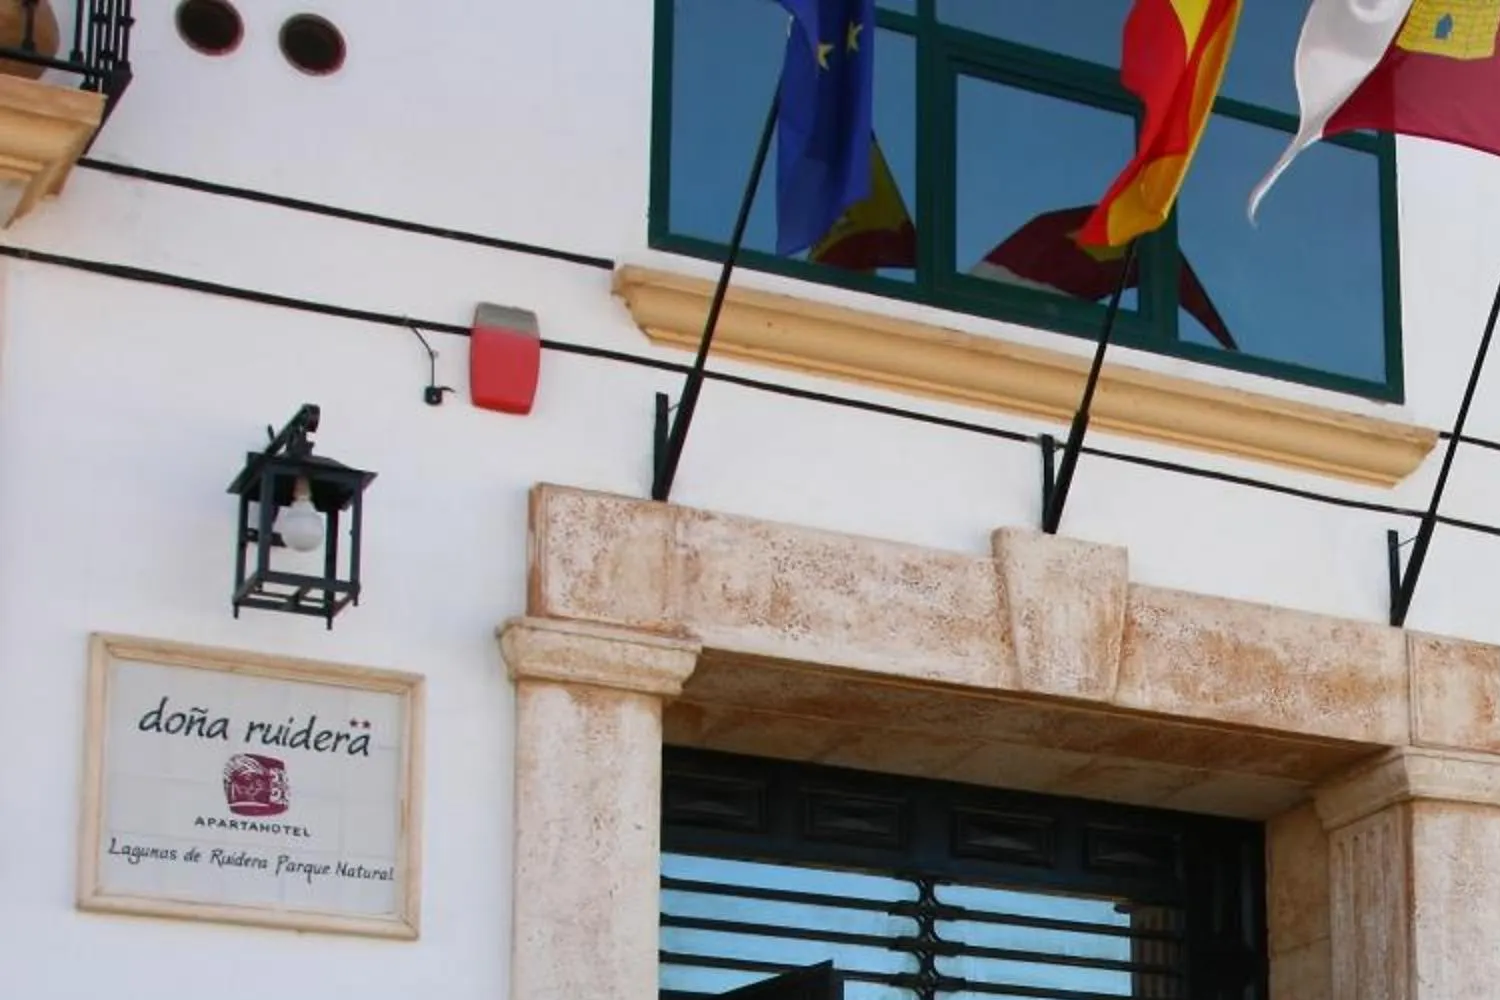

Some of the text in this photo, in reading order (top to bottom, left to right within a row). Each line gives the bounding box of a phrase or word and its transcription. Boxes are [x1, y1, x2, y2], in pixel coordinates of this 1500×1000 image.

[138, 696, 371, 757] doña ruidera
[195, 816, 312, 837] APARTAHOTEL
[108, 837, 395, 885] Lagunas de Ruidera Parque Natural
